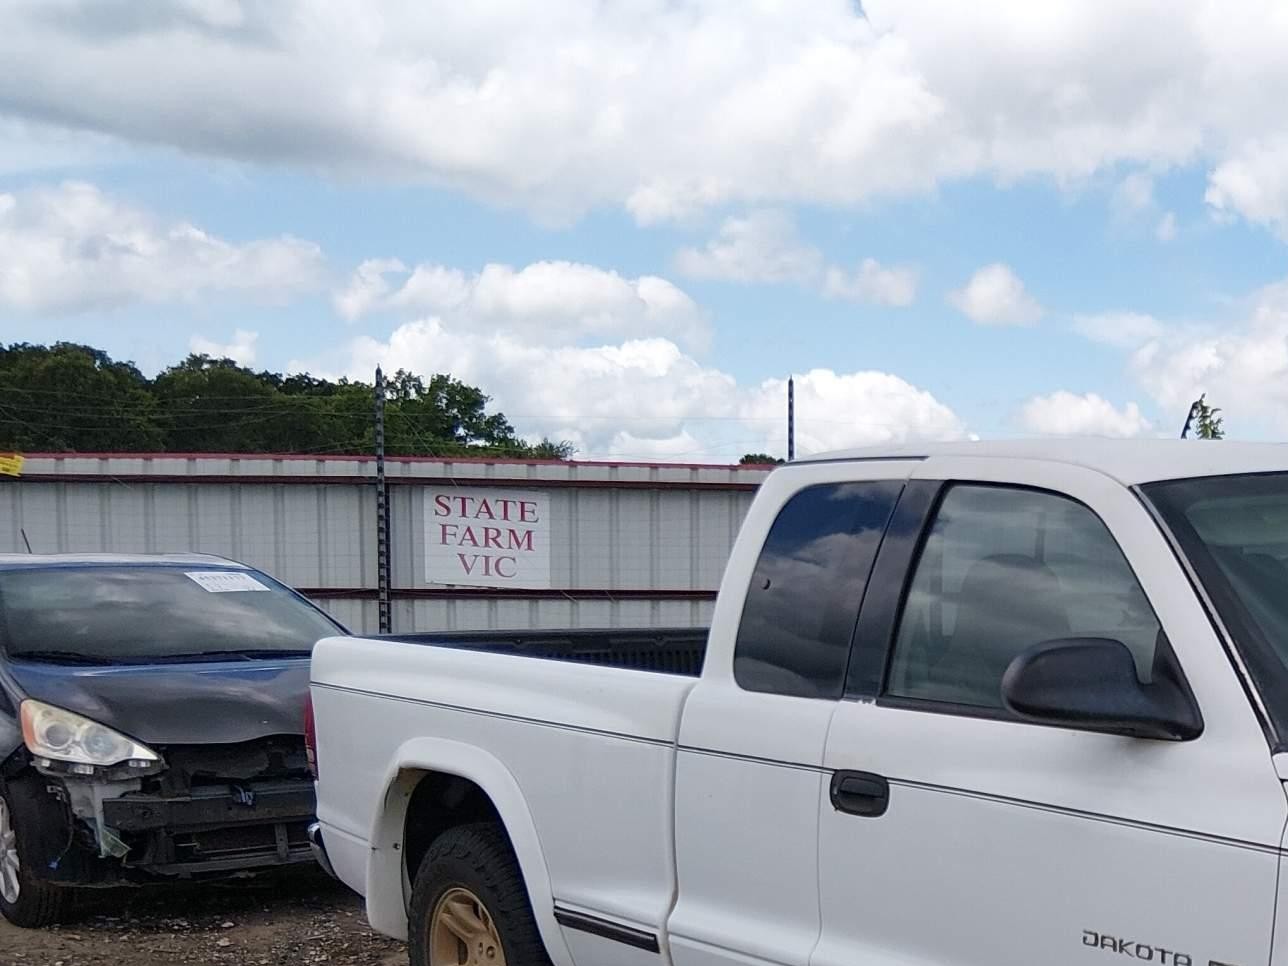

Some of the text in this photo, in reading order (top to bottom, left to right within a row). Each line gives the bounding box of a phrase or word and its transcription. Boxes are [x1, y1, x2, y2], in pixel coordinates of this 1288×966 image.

[434, 494, 540, 523] STATE
[439, 523, 535, 551] FARM
[457, 553, 517, 578] VIC
